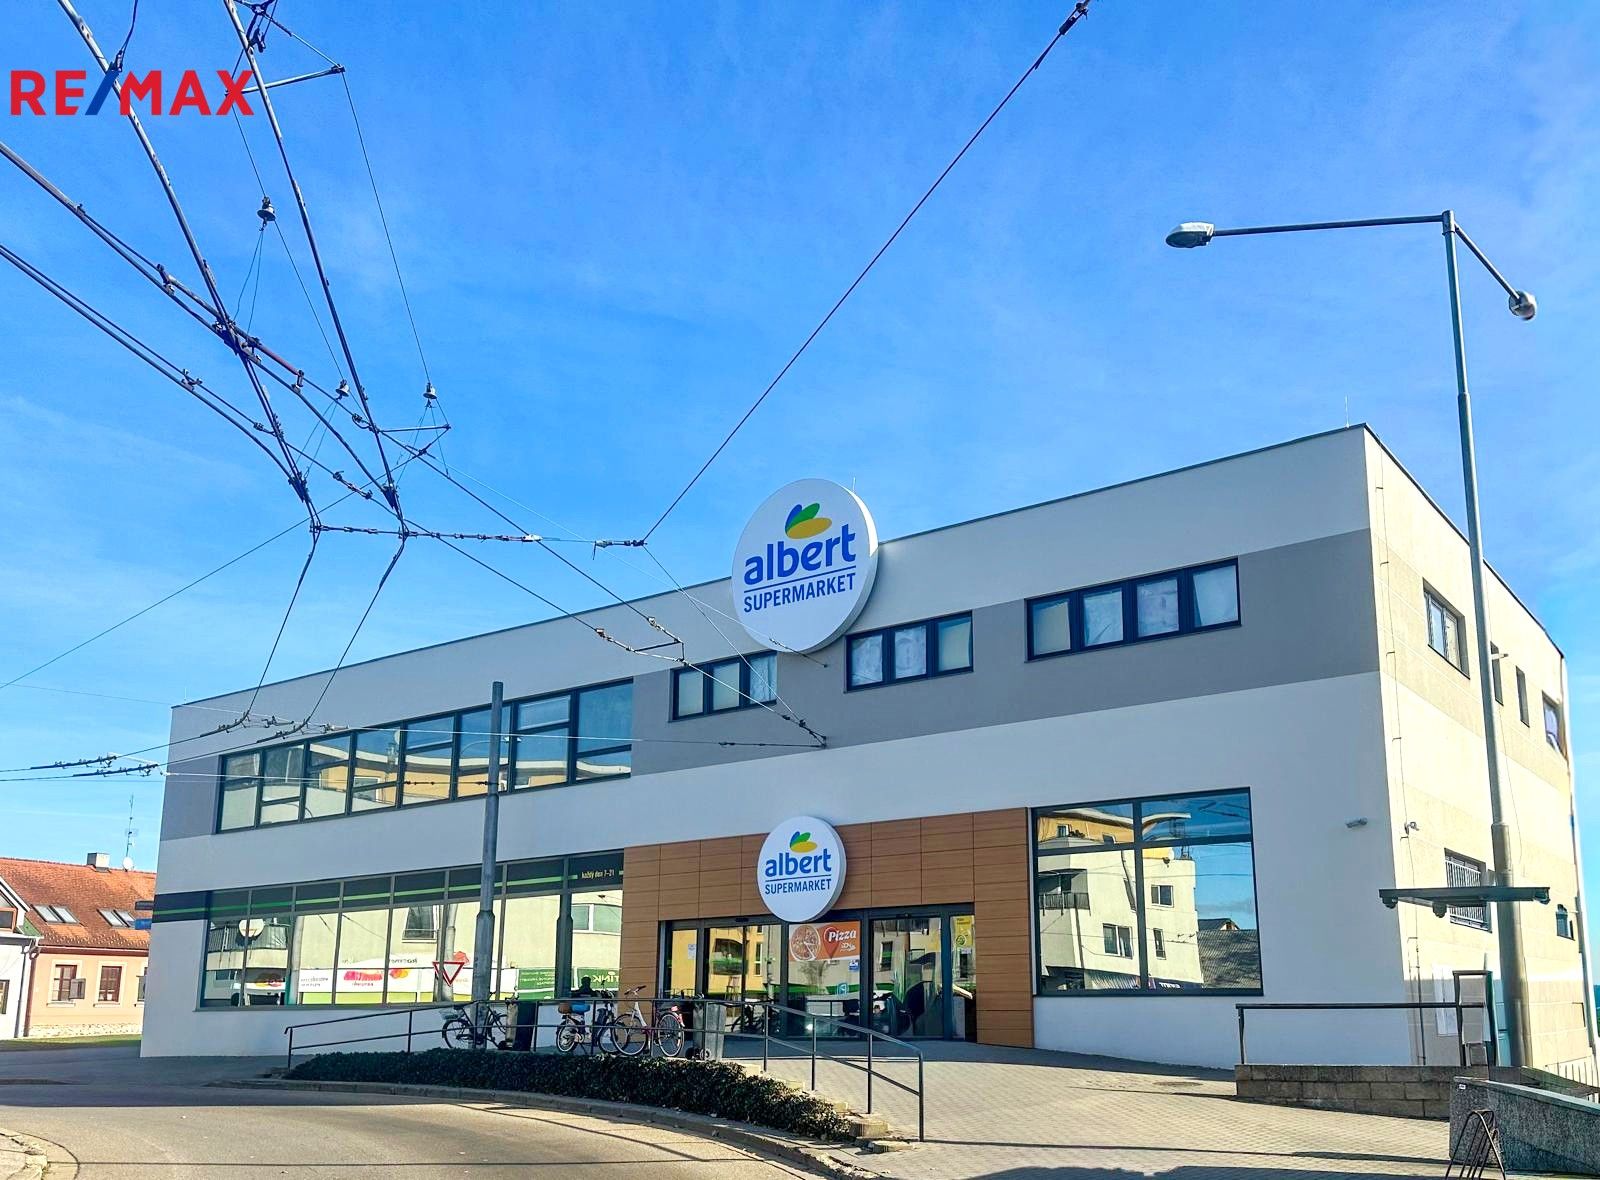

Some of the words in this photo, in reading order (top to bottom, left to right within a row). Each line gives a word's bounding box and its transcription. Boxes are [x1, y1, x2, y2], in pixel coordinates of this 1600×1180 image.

[743, 523, 857, 586] albert
[743, 572, 857, 613] SUPERMARKET
[765, 848, 832, 877] albert
[764, 878, 832, 895] SUPERMARKET
[828, 929, 857, 942] Pizza
